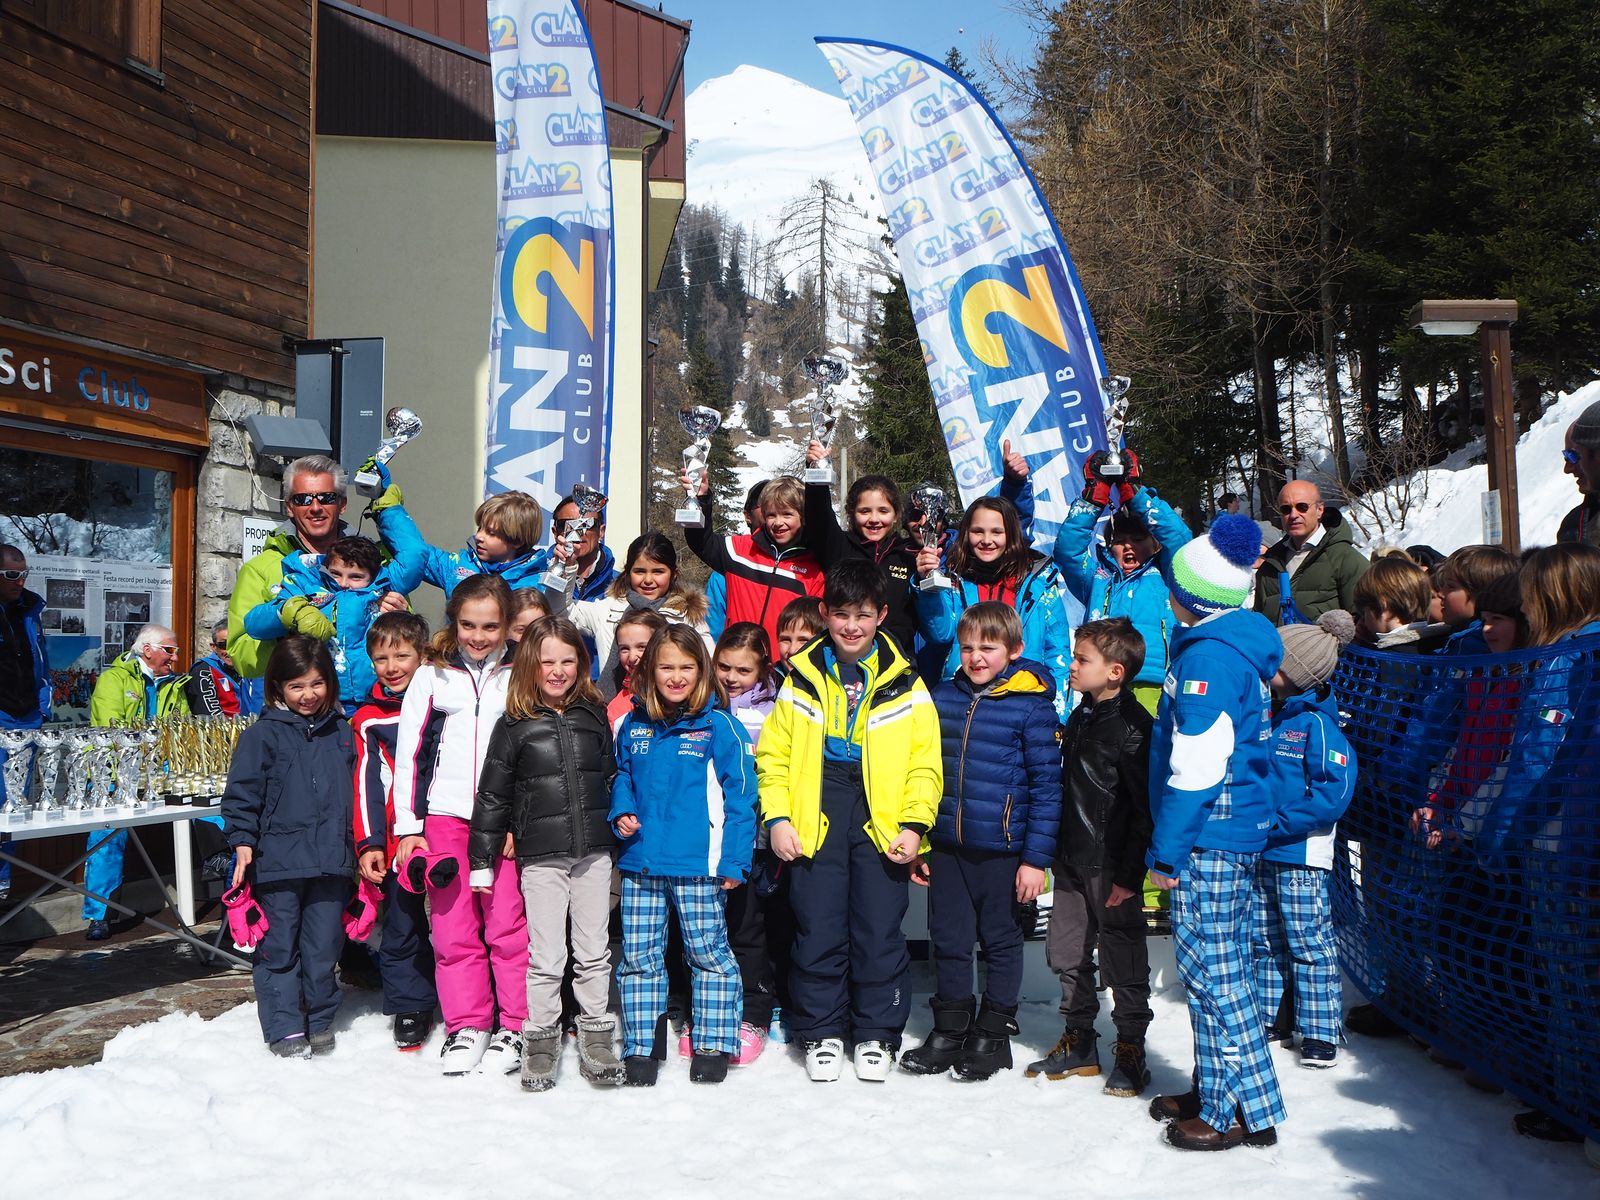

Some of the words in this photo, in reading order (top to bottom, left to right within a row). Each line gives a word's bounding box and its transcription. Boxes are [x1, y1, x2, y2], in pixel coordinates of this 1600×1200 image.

[547, 110, 602, 143] CLAN
[881, 134, 969, 191] CLAN2
[918, 210, 1005, 265] CLAN2
[0, 348, 52, 393] Sci
[79, 367, 149, 411] Club
[573, 353, 593, 445] CLUB
[1055, 365, 1093, 453] CLUB
[246, 528, 270, 540] PROP
[252, 546, 264, 556] PR
[104, 574, 117, 582] Festa
[136, 577, 144, 585] per
[147, 577, 160, 585] baby
